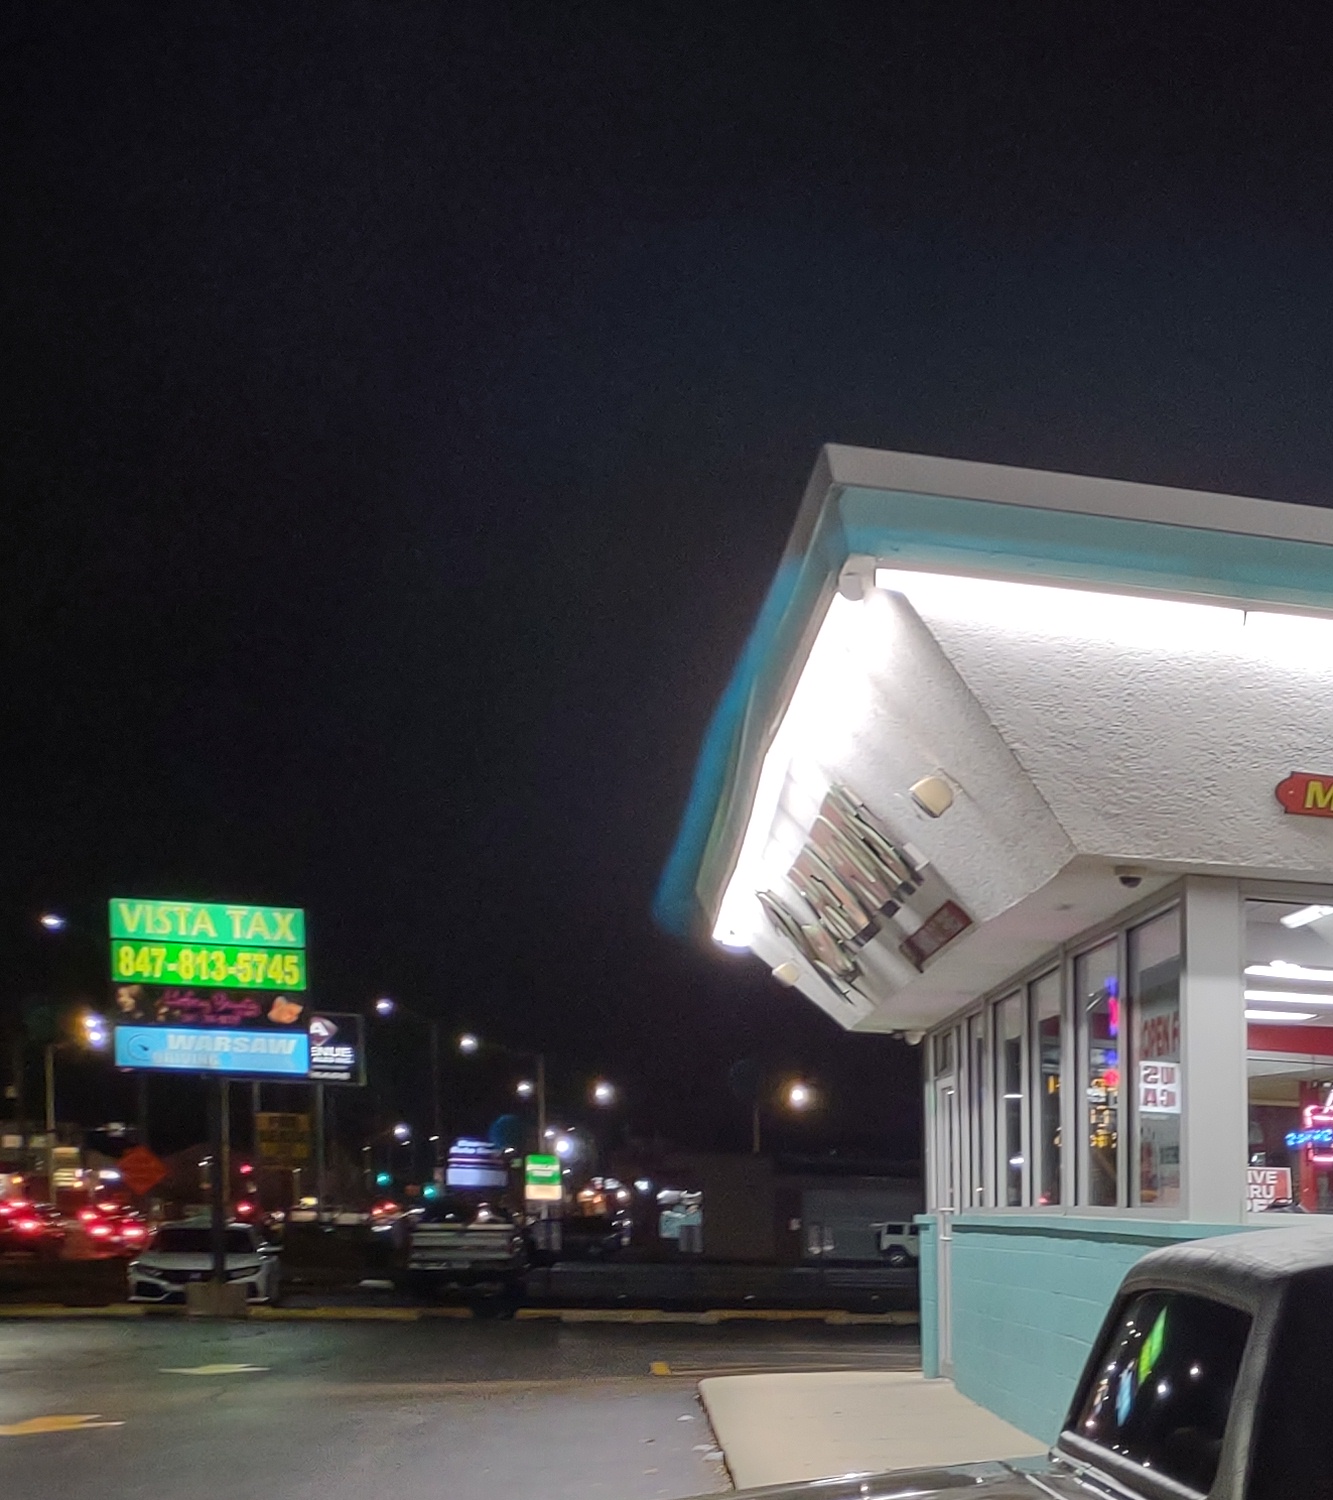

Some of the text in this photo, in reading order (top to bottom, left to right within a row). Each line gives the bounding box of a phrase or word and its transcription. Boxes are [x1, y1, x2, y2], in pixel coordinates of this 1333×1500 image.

[118, 903, 295, 942] VISTA TAX
[118, 945, 299, 985] 847-813-5745
[166, 1033, 297, 1055] WARSAW
[311, 1046, 353, 1058] ENUE
[1248, 1170, 1278, 1184] IVE
[1248, 1185, 1275, 1199] RU
